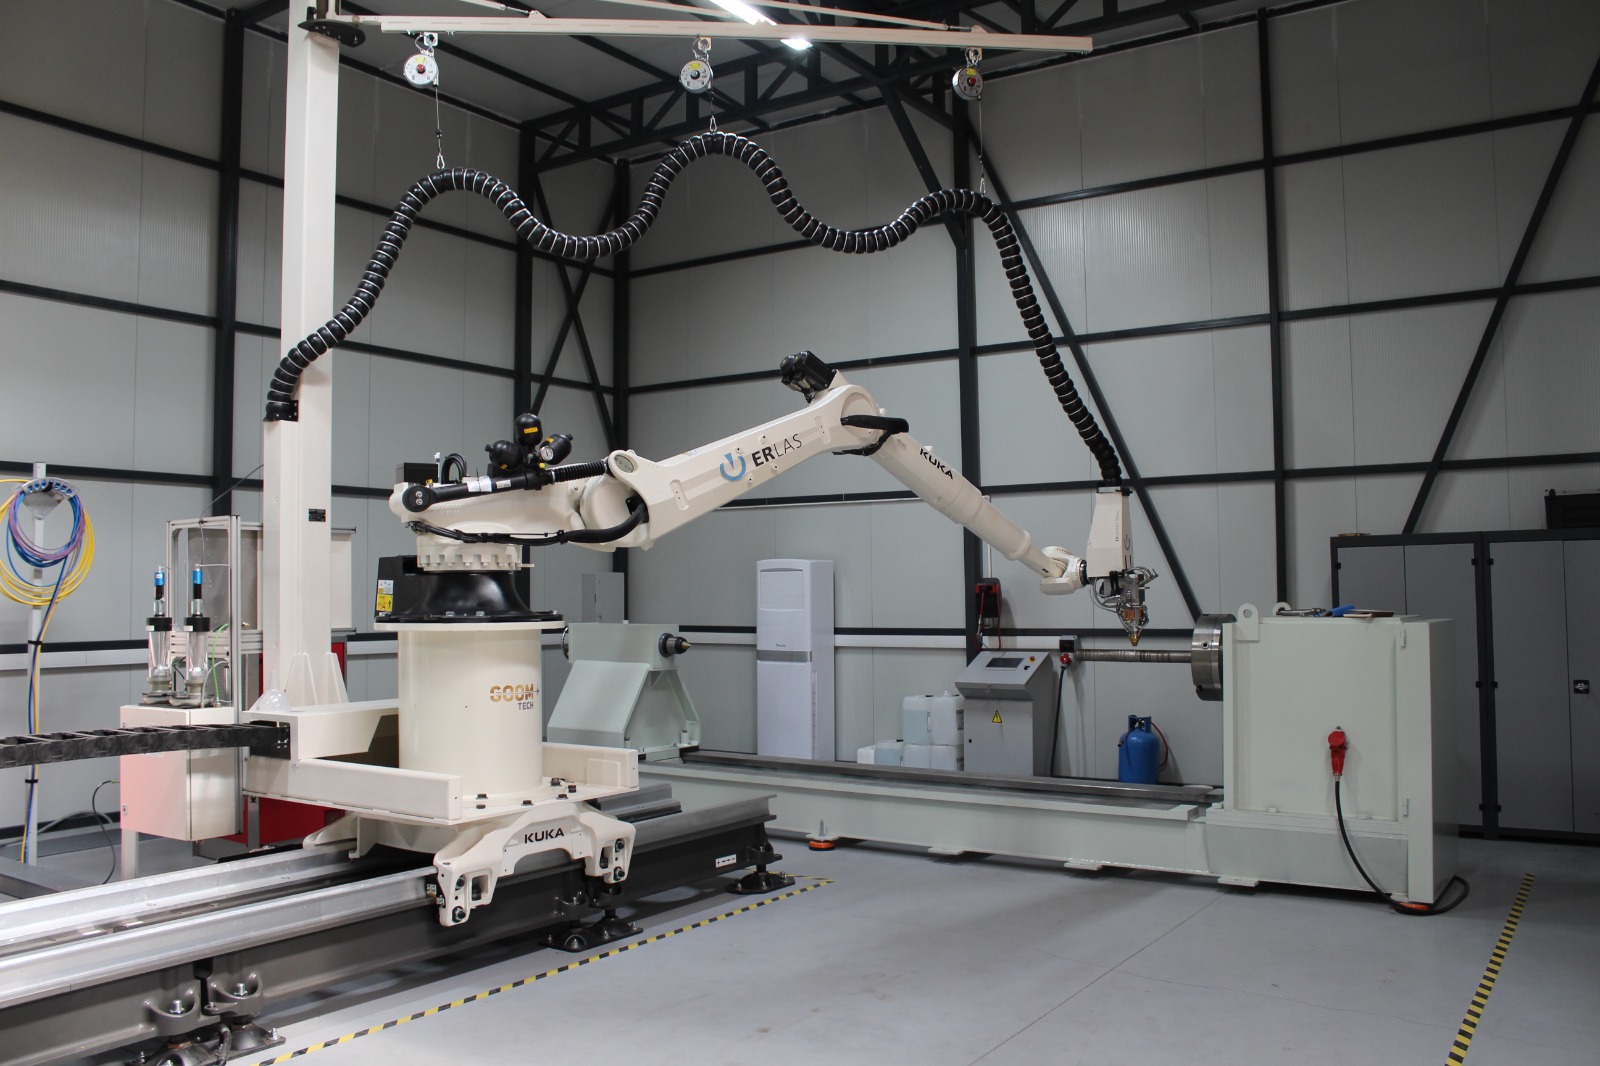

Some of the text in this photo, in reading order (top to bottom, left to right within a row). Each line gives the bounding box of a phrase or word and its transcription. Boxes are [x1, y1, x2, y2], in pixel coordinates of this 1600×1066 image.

[751, 433, 803, 467] ERLAS
[920, 448, 953, 479] KUKA
[490, 684, 534, 702] GOOM
[517, 702, 534, 711] TECH
[524, 828, 565, 844] KUKA
